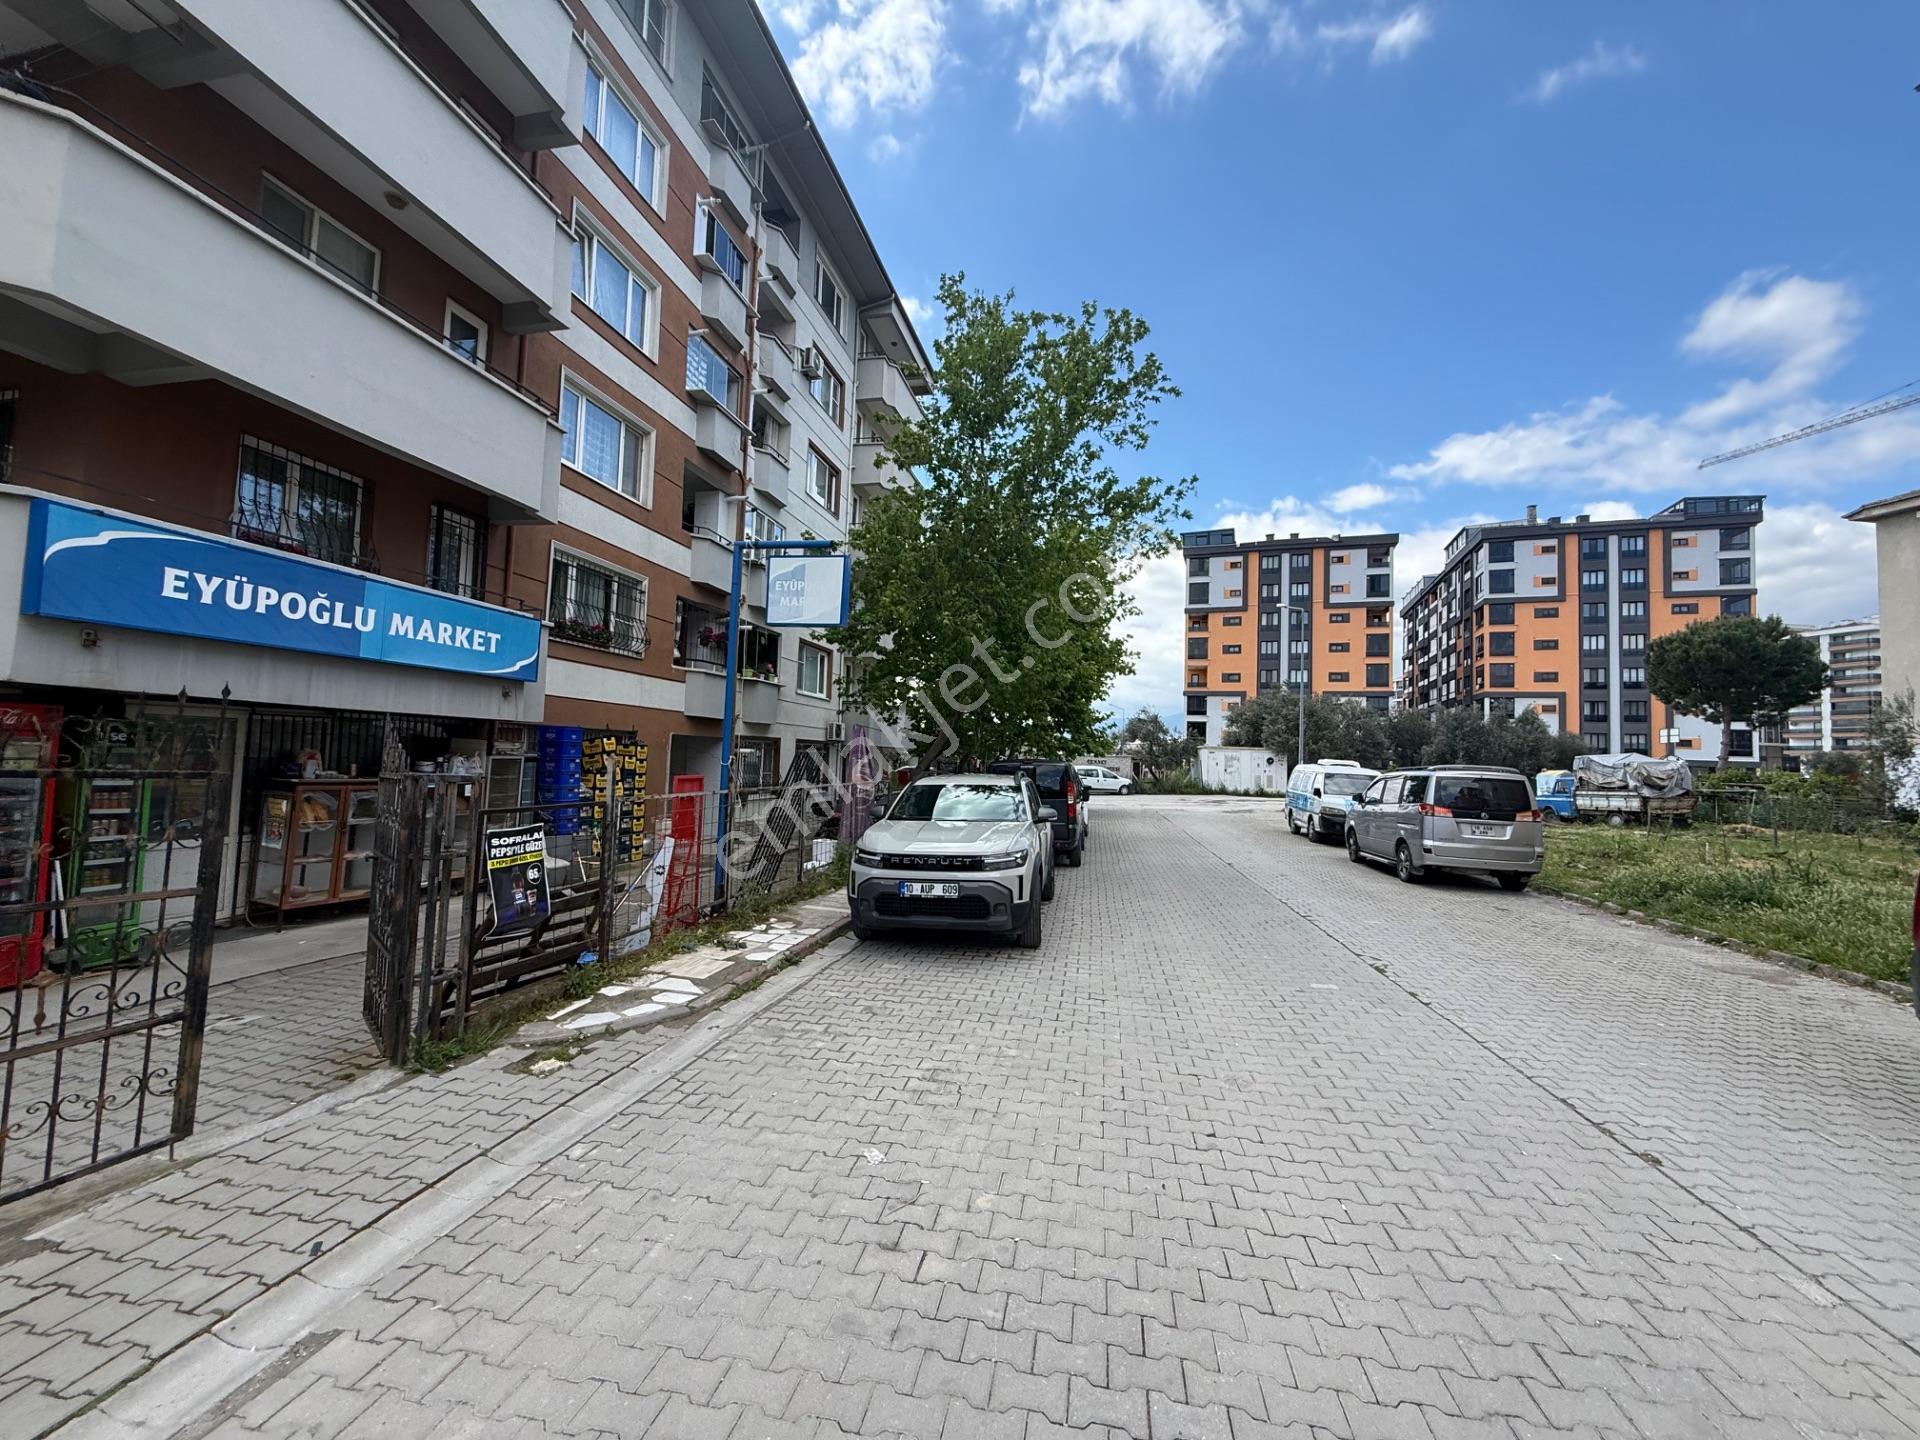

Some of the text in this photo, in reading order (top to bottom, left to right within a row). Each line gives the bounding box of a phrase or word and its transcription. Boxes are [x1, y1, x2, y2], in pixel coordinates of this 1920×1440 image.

[161, 566, 502, 653] EYÜPOĞLU MARKET
[890, 857, 972, 865] RENAULT
[905, 884, 958, 895] 10 AUP 609
